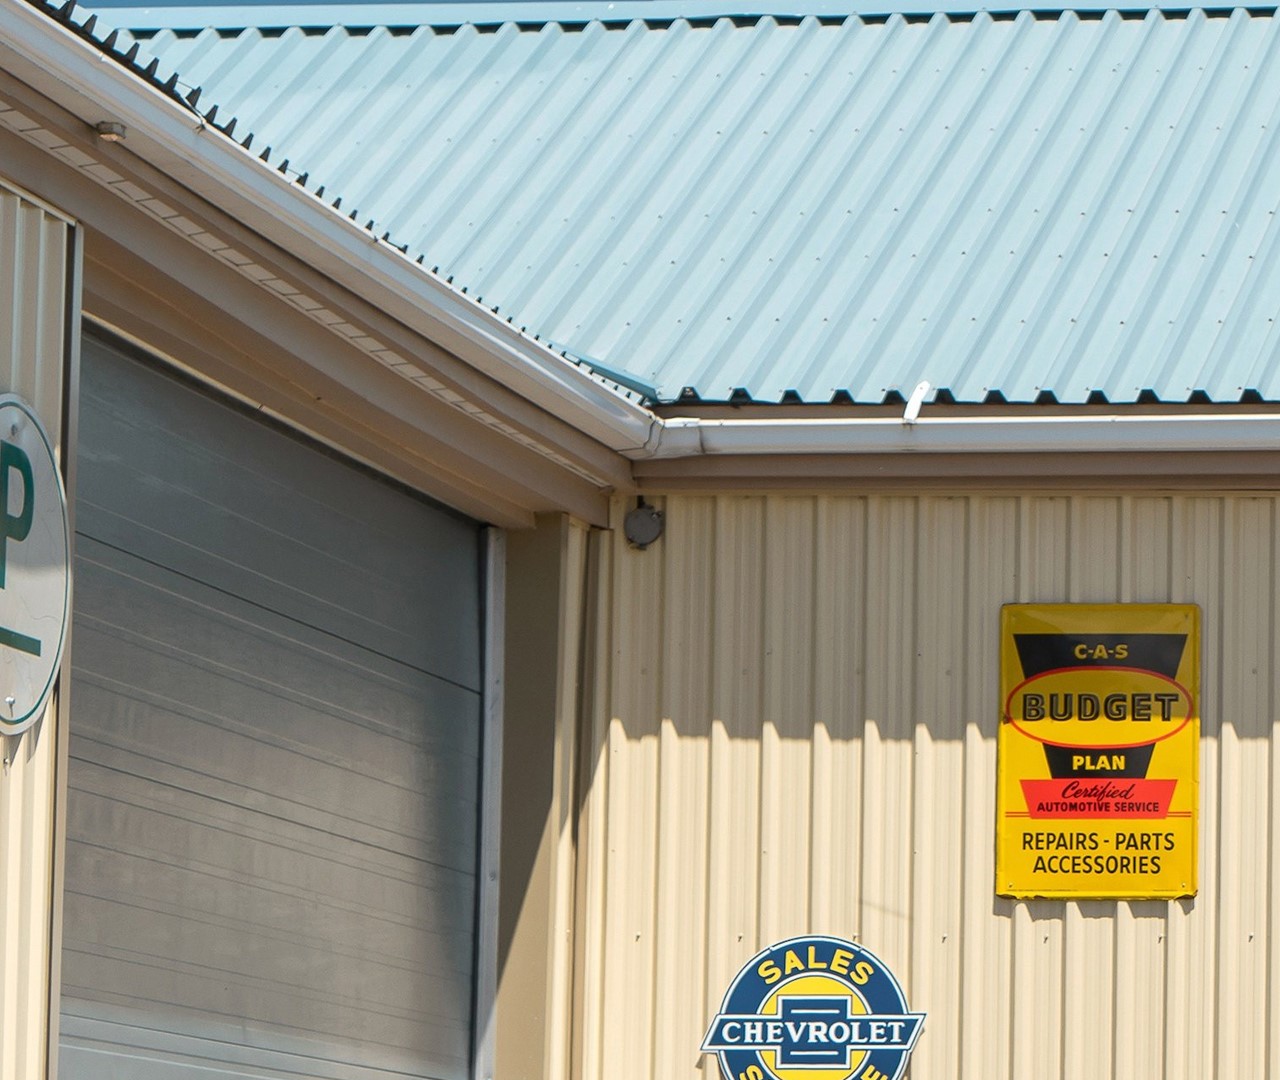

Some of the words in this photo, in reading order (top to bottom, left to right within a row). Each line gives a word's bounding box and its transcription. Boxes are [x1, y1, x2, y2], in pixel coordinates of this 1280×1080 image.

[1074, 644, 1128, 660] C-A-S
[1022, 693, 1179, 722] BUDGET
[1072, 755, 1126, 770] PLAN
[1061, 780, 1136, 804] Certified
[1036, 802, 1111, 813] AUTOMOTIVE
[1114, 802, 1160, 813] SERVICE
[1022, 832, 1099, 851] REPAIRS
[1115, 832, 1175, 851] PARTS
[1033, 856, 1161, 874] ACCESSORIES
[757, 945, 875, 985] SALES
[721, 1021, 906, 1044] CHEVROLET
